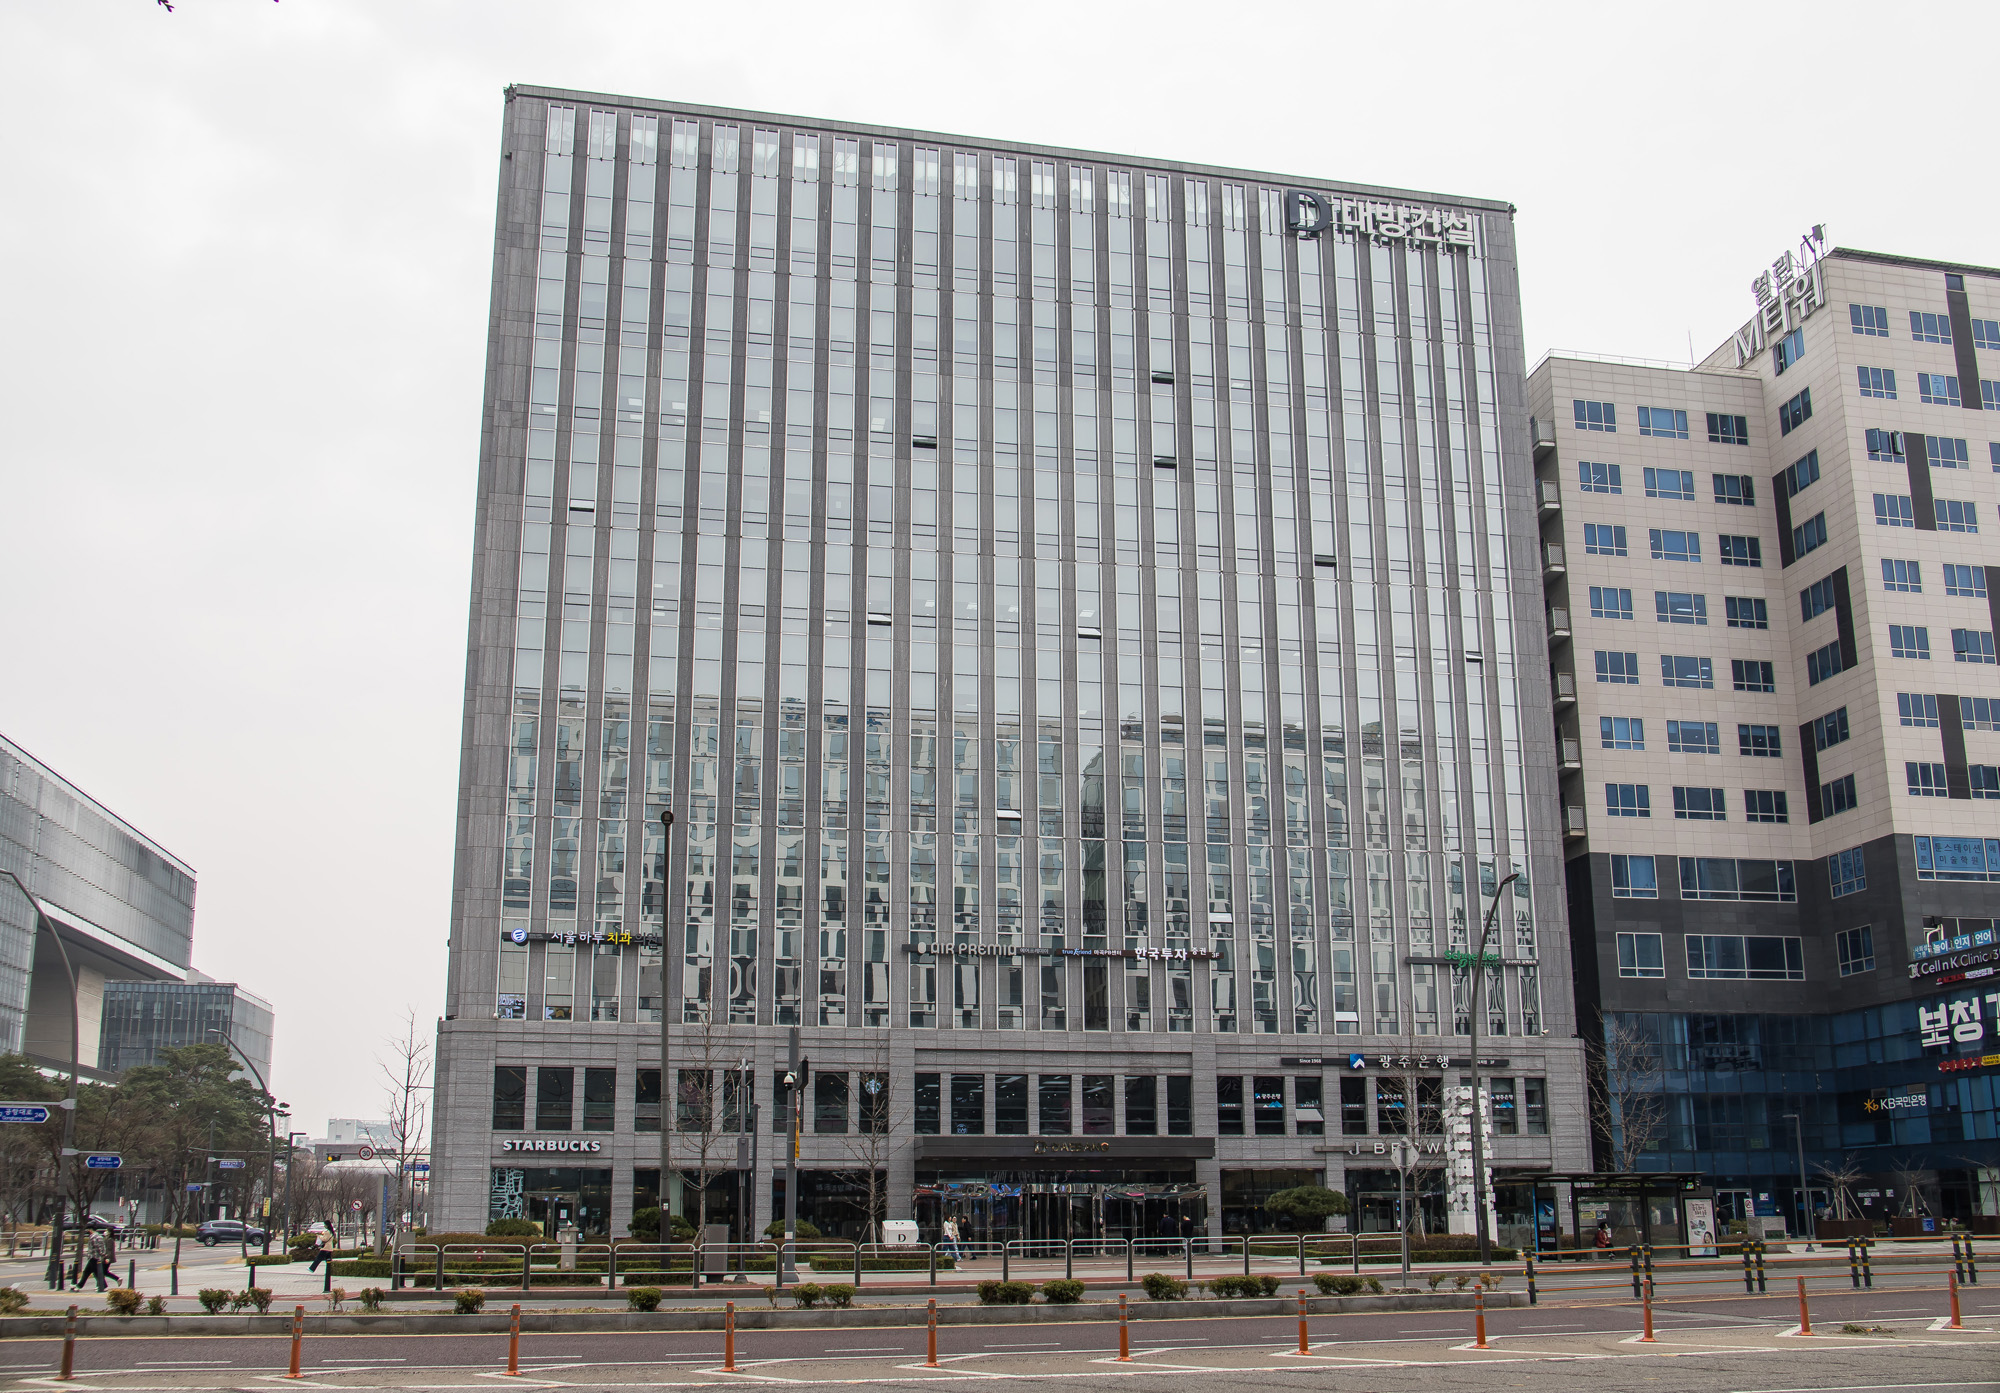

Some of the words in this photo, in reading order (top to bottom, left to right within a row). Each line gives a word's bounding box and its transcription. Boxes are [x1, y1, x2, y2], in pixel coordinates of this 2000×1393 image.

[1341, 199, 1475, 247] 대방건설
[1940, 855, 1979, 865] 미술학원
[1954, 935, 1971, 949] 인지
[1974, 930, 1992, 944] 언어
[1444, 950, 1500, 961] Schneder
[1960, 951, 1989, 967] Clinic
[1378, 1055, 1450, 1069] 광주은행
[1880, 1094, 1927, 1110] KB국민은행
[503, 1140, 600, 1151] STARBUCKS
